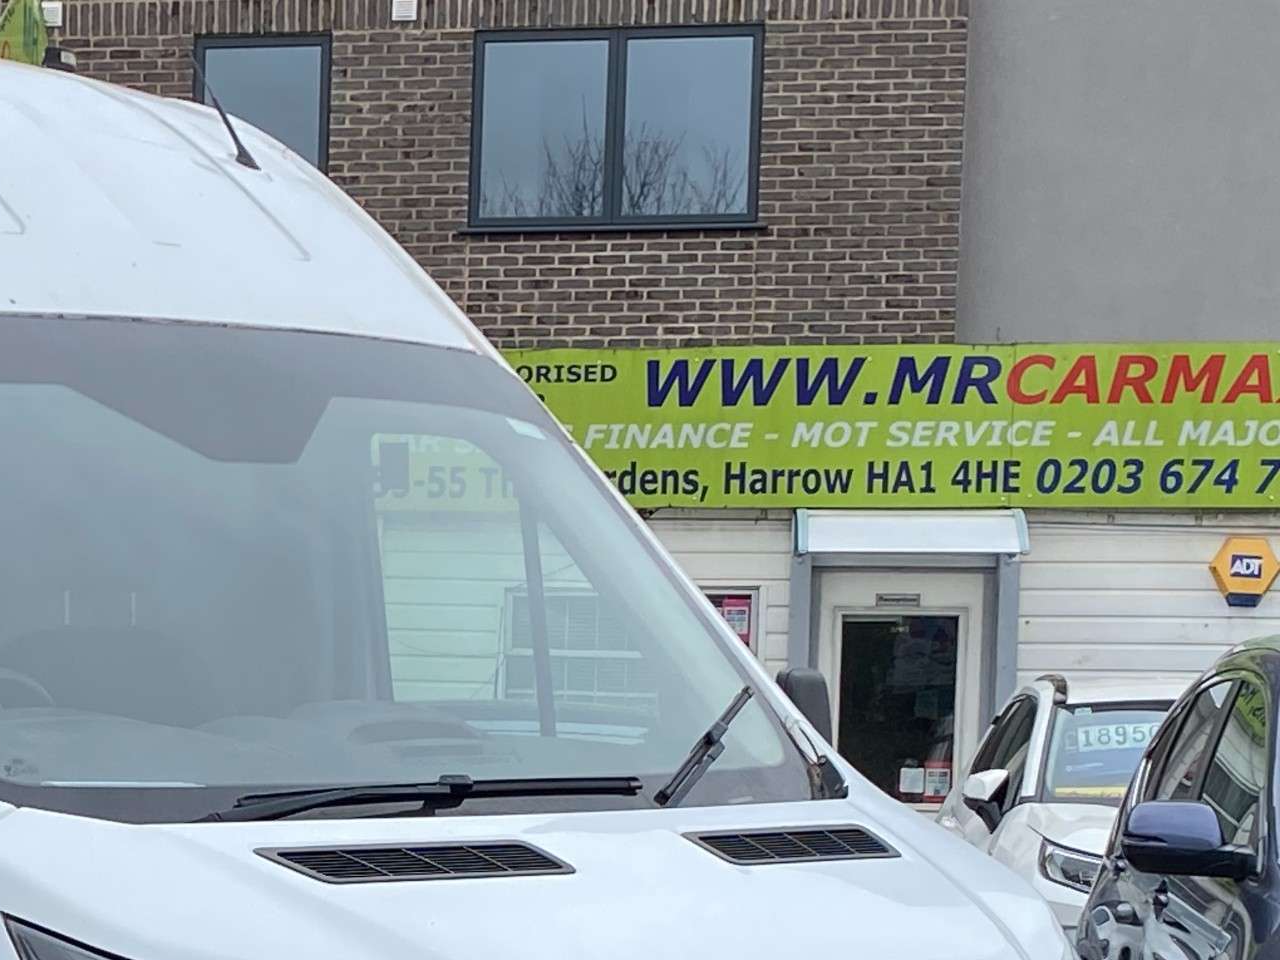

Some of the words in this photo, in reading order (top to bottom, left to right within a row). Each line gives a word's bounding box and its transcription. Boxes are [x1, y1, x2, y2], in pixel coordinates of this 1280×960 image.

[646, 354, 1280, 408] WWW.MRCARMA
[583, 422, 754, 449] FINANCE
[791, 420, 878, 448] MOT
[885, 420, 1057, 448] SERVICE
[1092, 420, 1164, 447] ALL
[724, 461, 854, 495] Harrow
[867, 460, 937, 494] HA1
[950, 460, 1021, 494] 4HE
[1036, 458, 1145, 494] 0203
[1159, 458, 1240, 494] 674
[1230, 558, 1262, 576] ADT
